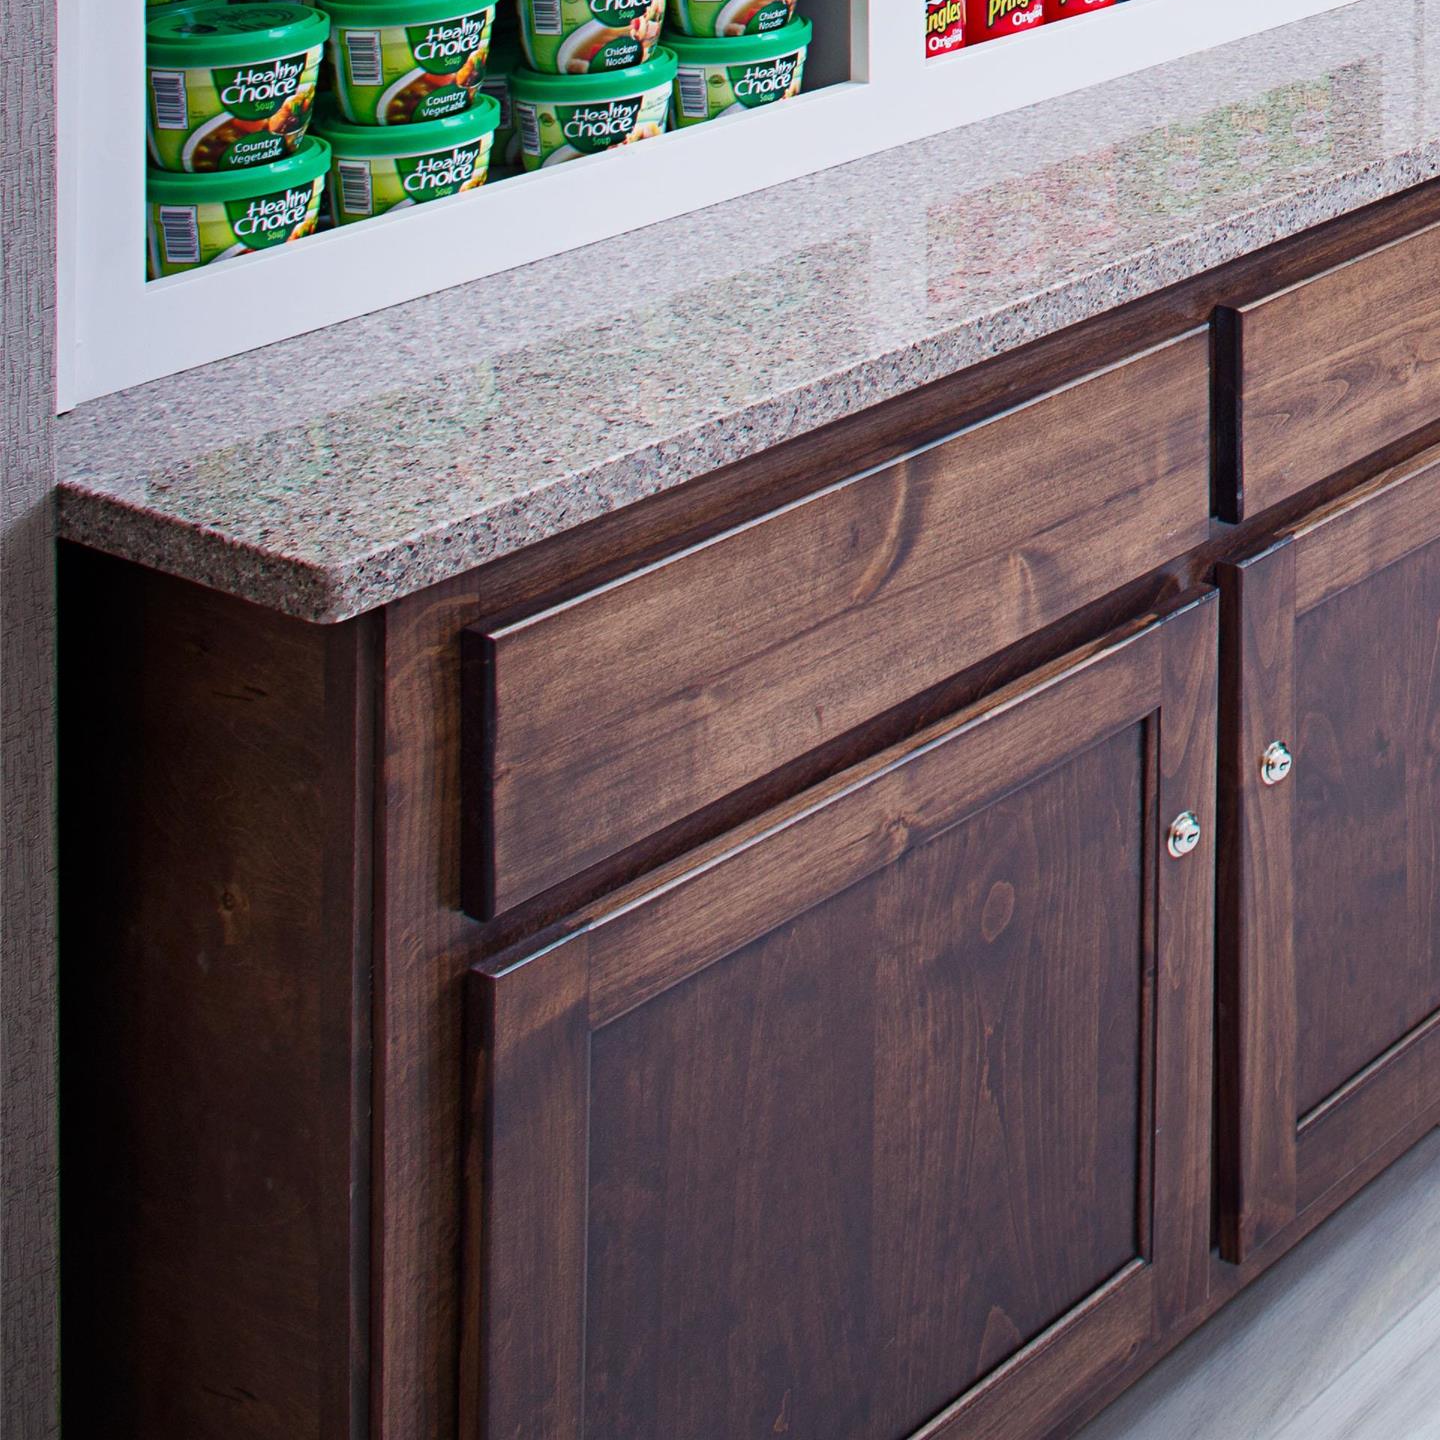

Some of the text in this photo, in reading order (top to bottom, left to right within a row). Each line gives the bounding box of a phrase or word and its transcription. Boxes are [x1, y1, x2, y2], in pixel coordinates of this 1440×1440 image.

[758, 9, 787, 23] Chicken
[758, 17, 783, 31] Noodle
[427, 18, 485, 43] Healthy
[414, 33, 480, 60] Choice
[604, 44, 638, 58] Chicken
[605, 53, 635, 67] Noodle
[743, 59, 797, 81] Healthy
[235, 61, 303, 87] Healthy
[734, 73, 792, 96] Choice
[220, 77, 296, 105] Choice
[426, 90, 466, 108] Country
[422, 99, 466, 118] Vegetable
[572, 102, 639, 122] Healthy
[563, 116, 633, 139] Choice
[229, 146, 282, 166] Vegetable
[234, 137, 282, 156] Country
[416, 149, 479, 174] Healthy
[404, 164, 472, 192] Choice
[247, 186, 312, 218] Healthy
[234, 204, 306, 237] Choice
[267, 228, 286, 242] Soup
